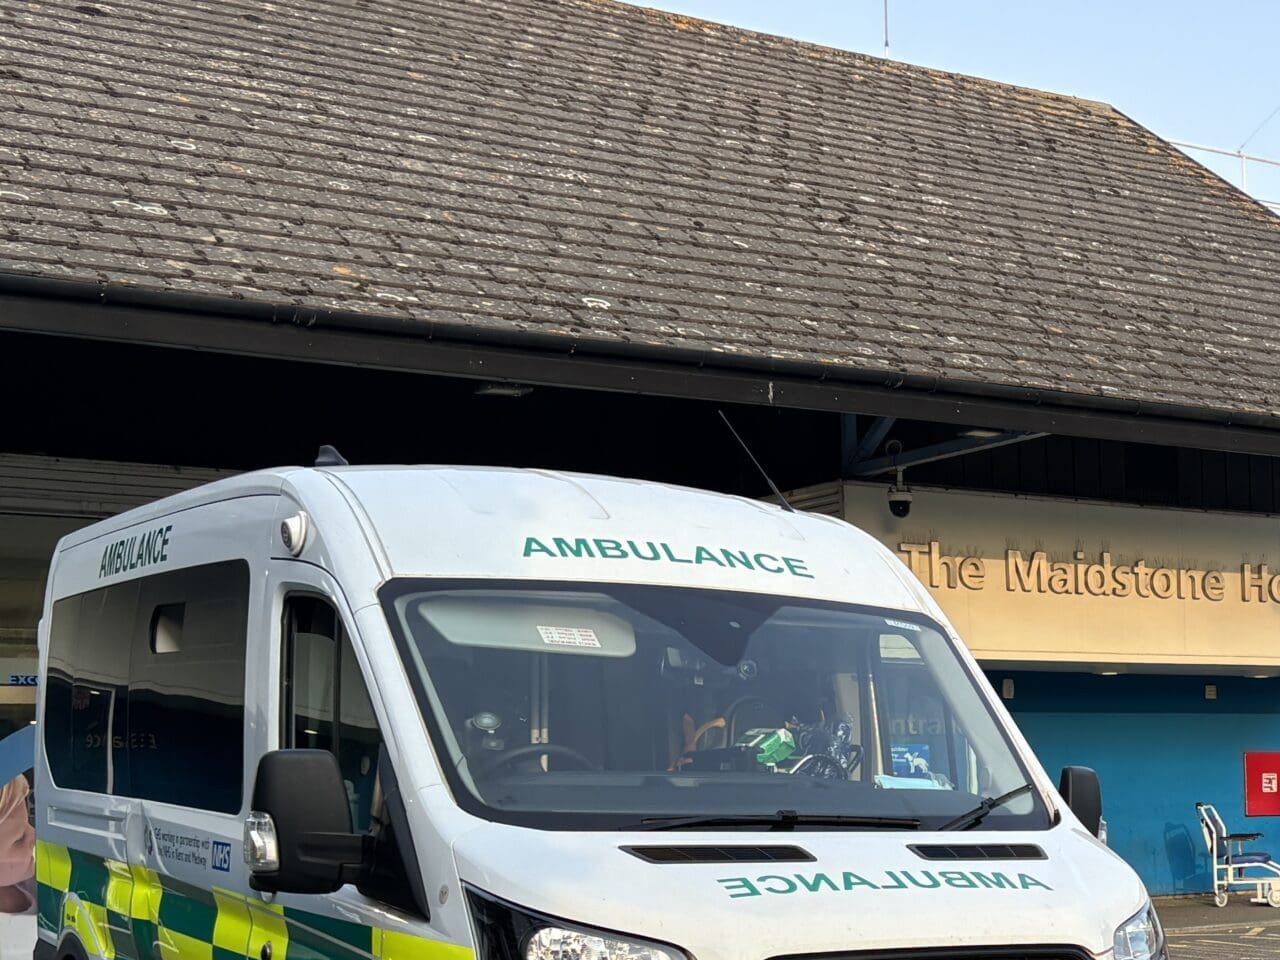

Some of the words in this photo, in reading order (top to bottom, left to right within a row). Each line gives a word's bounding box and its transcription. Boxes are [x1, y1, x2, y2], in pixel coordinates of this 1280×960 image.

[99, 525, 173, 578] AMBULANCE
[522, 537, 815, 579] AMBULANCE
[898, 540, 985, 590] The
[1005, 548, 1225, 601] Maidstone
[212, 843, 230, 869] NHS
